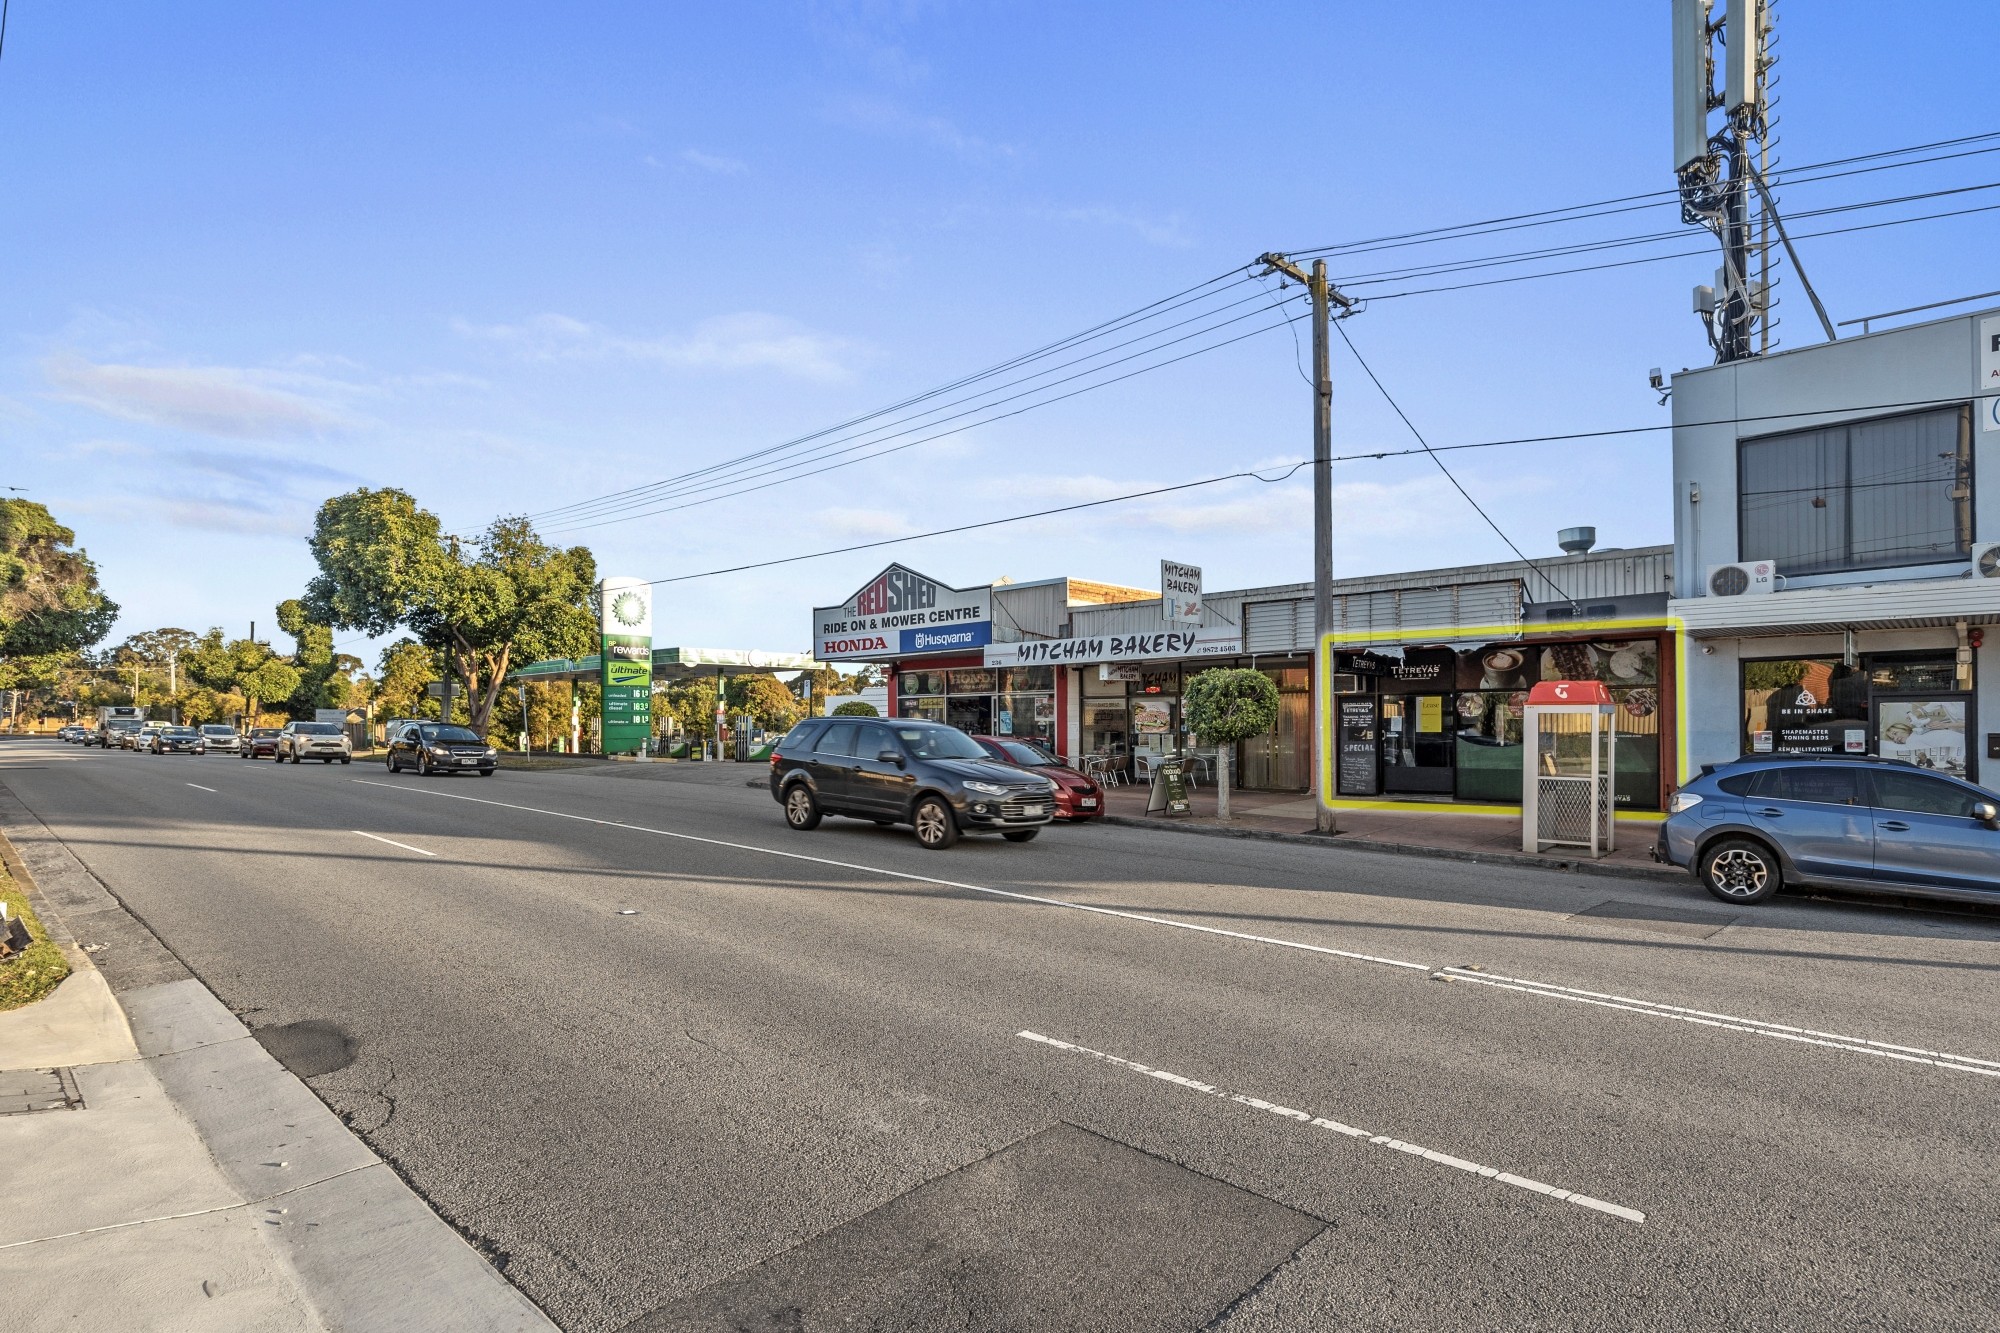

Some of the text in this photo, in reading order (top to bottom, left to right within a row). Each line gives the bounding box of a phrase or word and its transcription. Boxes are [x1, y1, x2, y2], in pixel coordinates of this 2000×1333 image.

[1164, 563, 1201, 581] MITCHAM
[843, 572, 936, 618] THE RED SHED
[1166, 578, 1200, 596] BAKERY
[824, 606, 980, 634] RIDE ON & MOWER CENTRE
[824, 637, 888, 653] HONDA
[925, 632, 972, 645] Husqvarna
[613, 646, 649, 655] rewards
[1017, 640, 1104, 662] MITCHAM
[1110, 632, 1196, 657] BAKERY
[610, 666, 648, 675] ultimate
[1117, 665, 1138, 673] MITCHAM
[1344, 744, 1375, 752] SPECIAL
